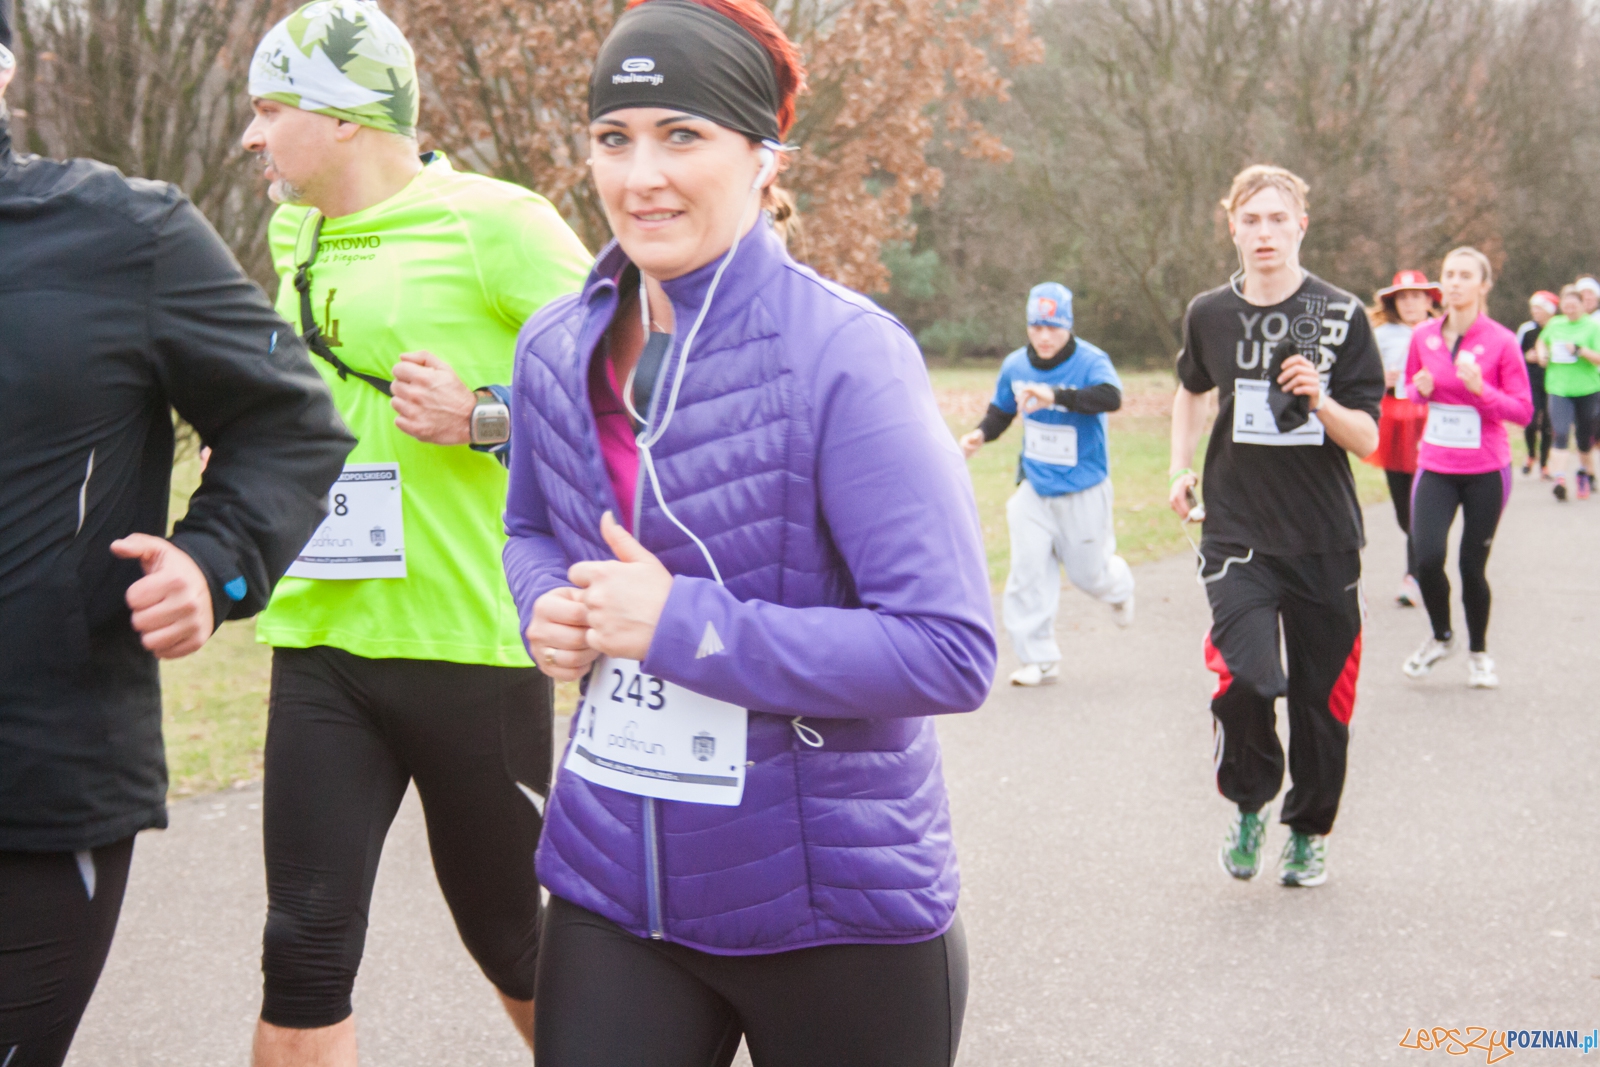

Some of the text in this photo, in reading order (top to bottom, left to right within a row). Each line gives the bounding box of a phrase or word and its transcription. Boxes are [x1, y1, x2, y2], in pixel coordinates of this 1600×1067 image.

[333, 253, 376, 266] biegowo
[1238, 311, 1289, 341] YO
[334, 493, 348, 516] 8
[610, 668, 667, 710] 243
